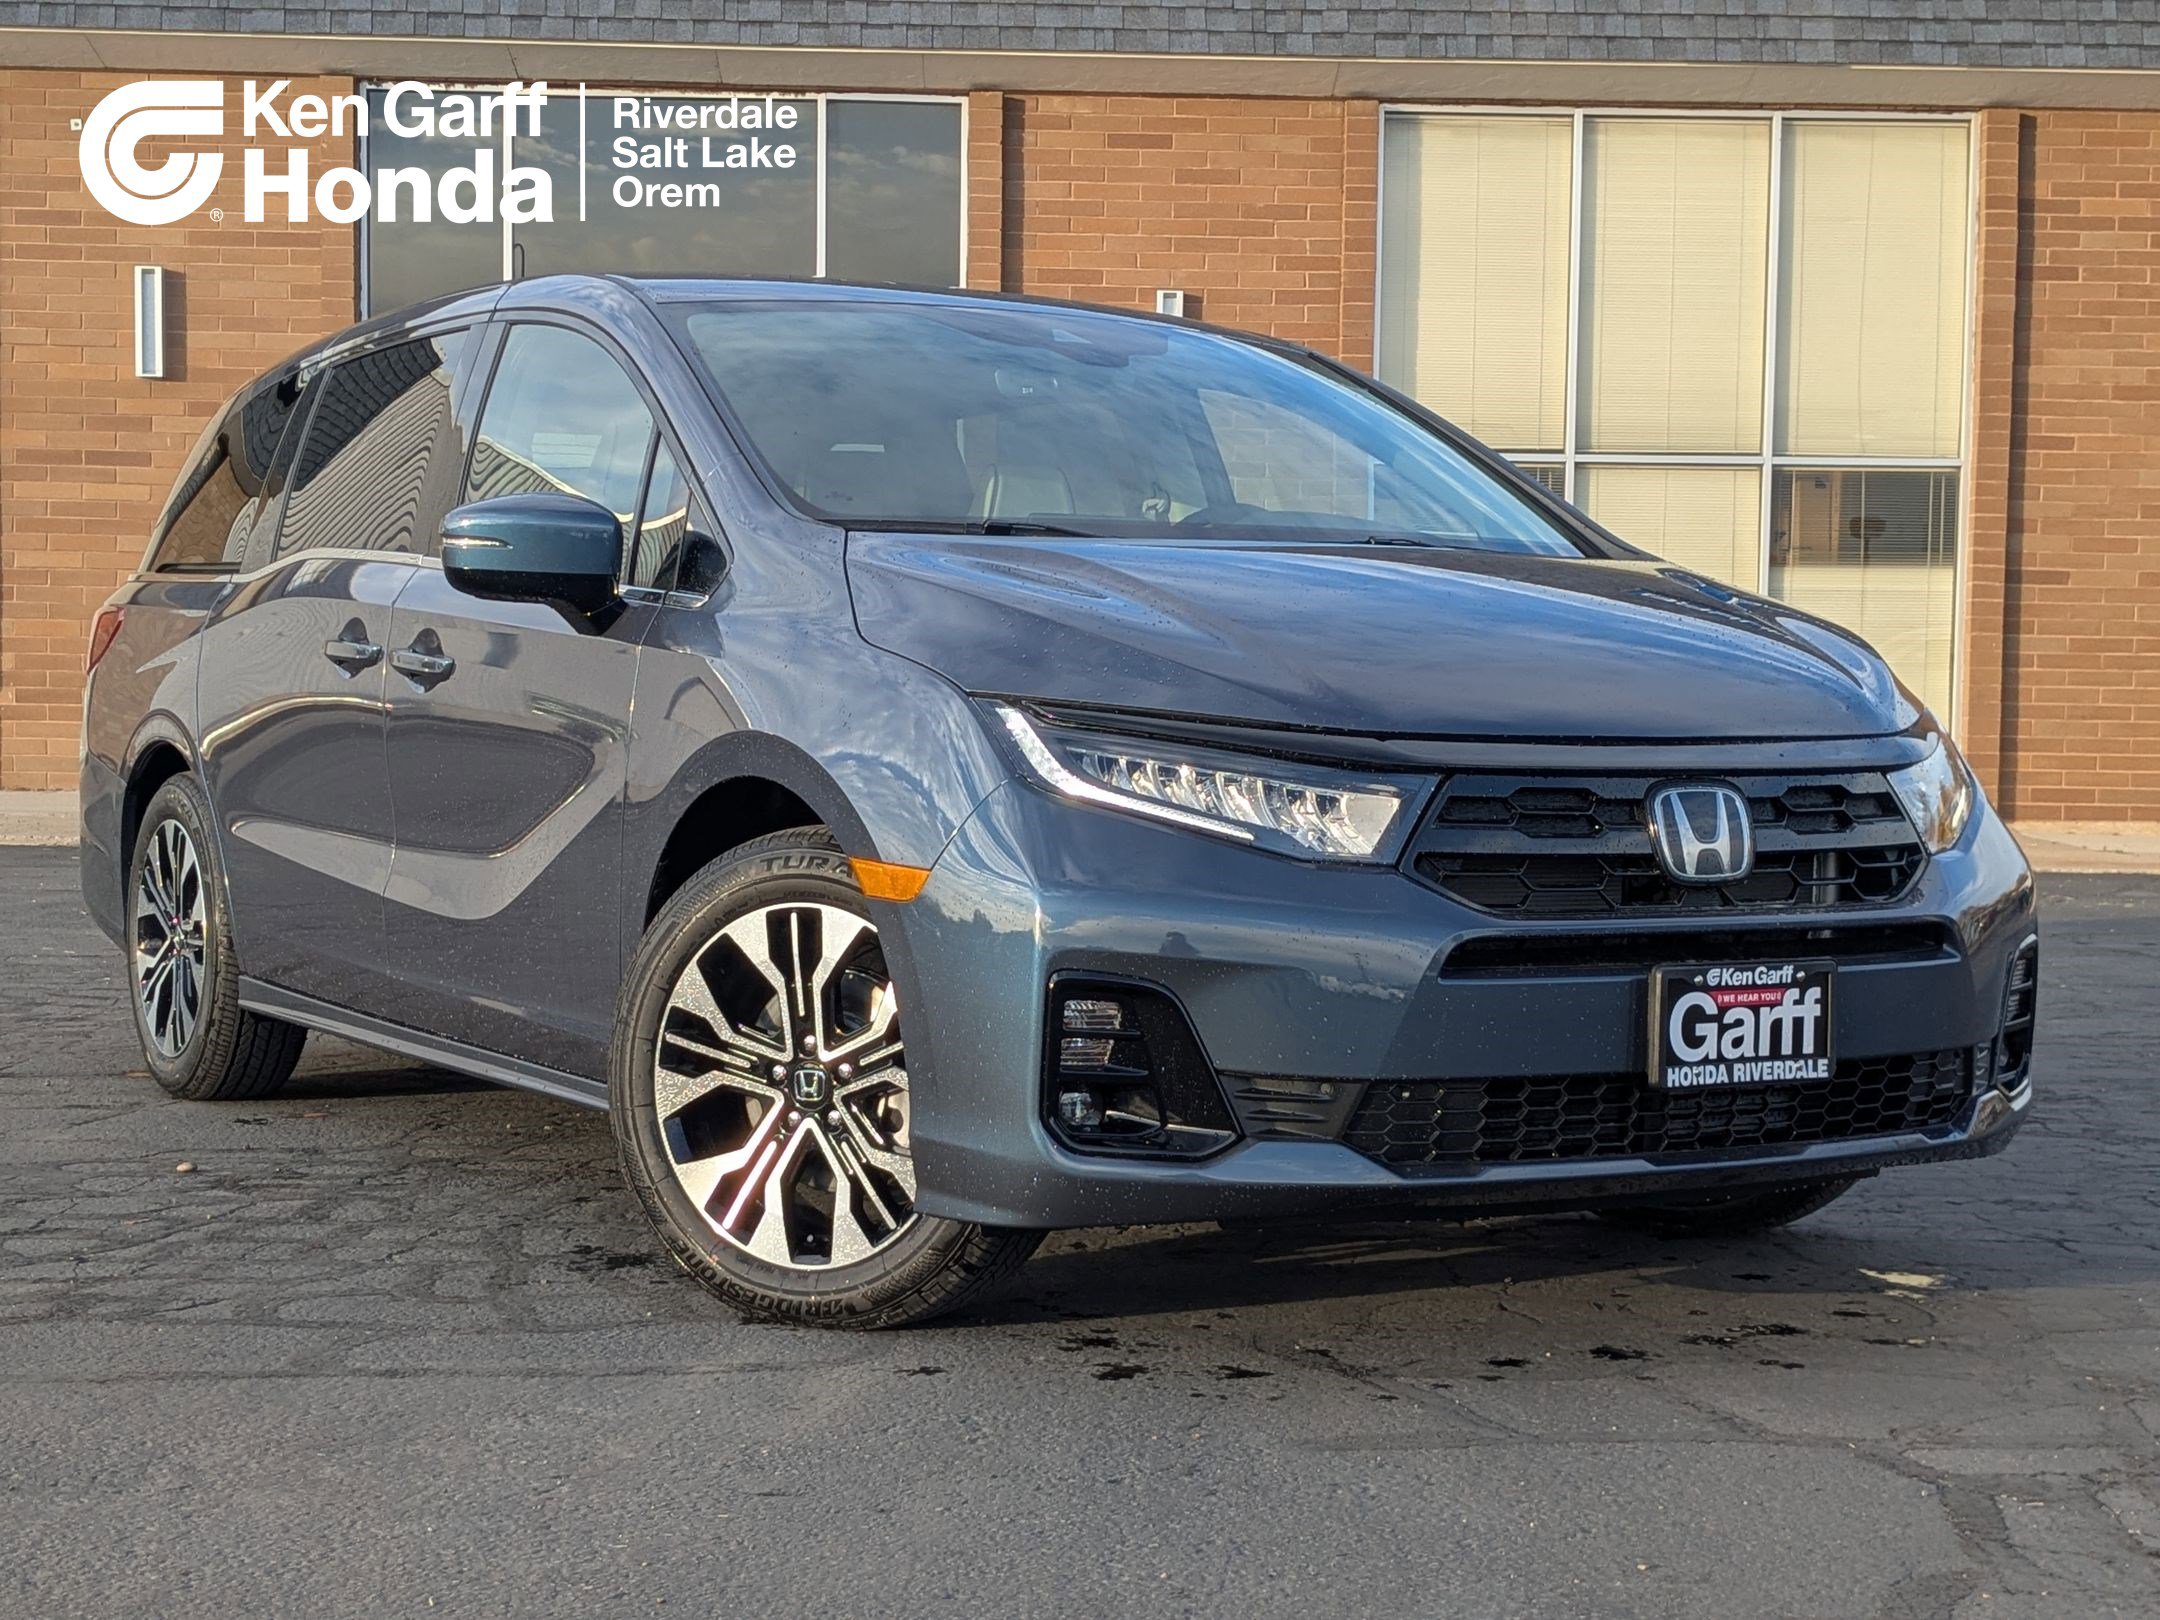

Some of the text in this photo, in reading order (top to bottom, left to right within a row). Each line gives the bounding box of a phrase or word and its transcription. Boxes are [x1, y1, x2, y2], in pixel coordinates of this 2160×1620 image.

[1721, 965, 1794, 986] Ken Garff
[1723, 992, 1777, 1003] WE HEAR YOU
[1669, 987, 1822, 1062] Garff
[1667, 1059, 1829, 1088] HONDA RIVERDALE
